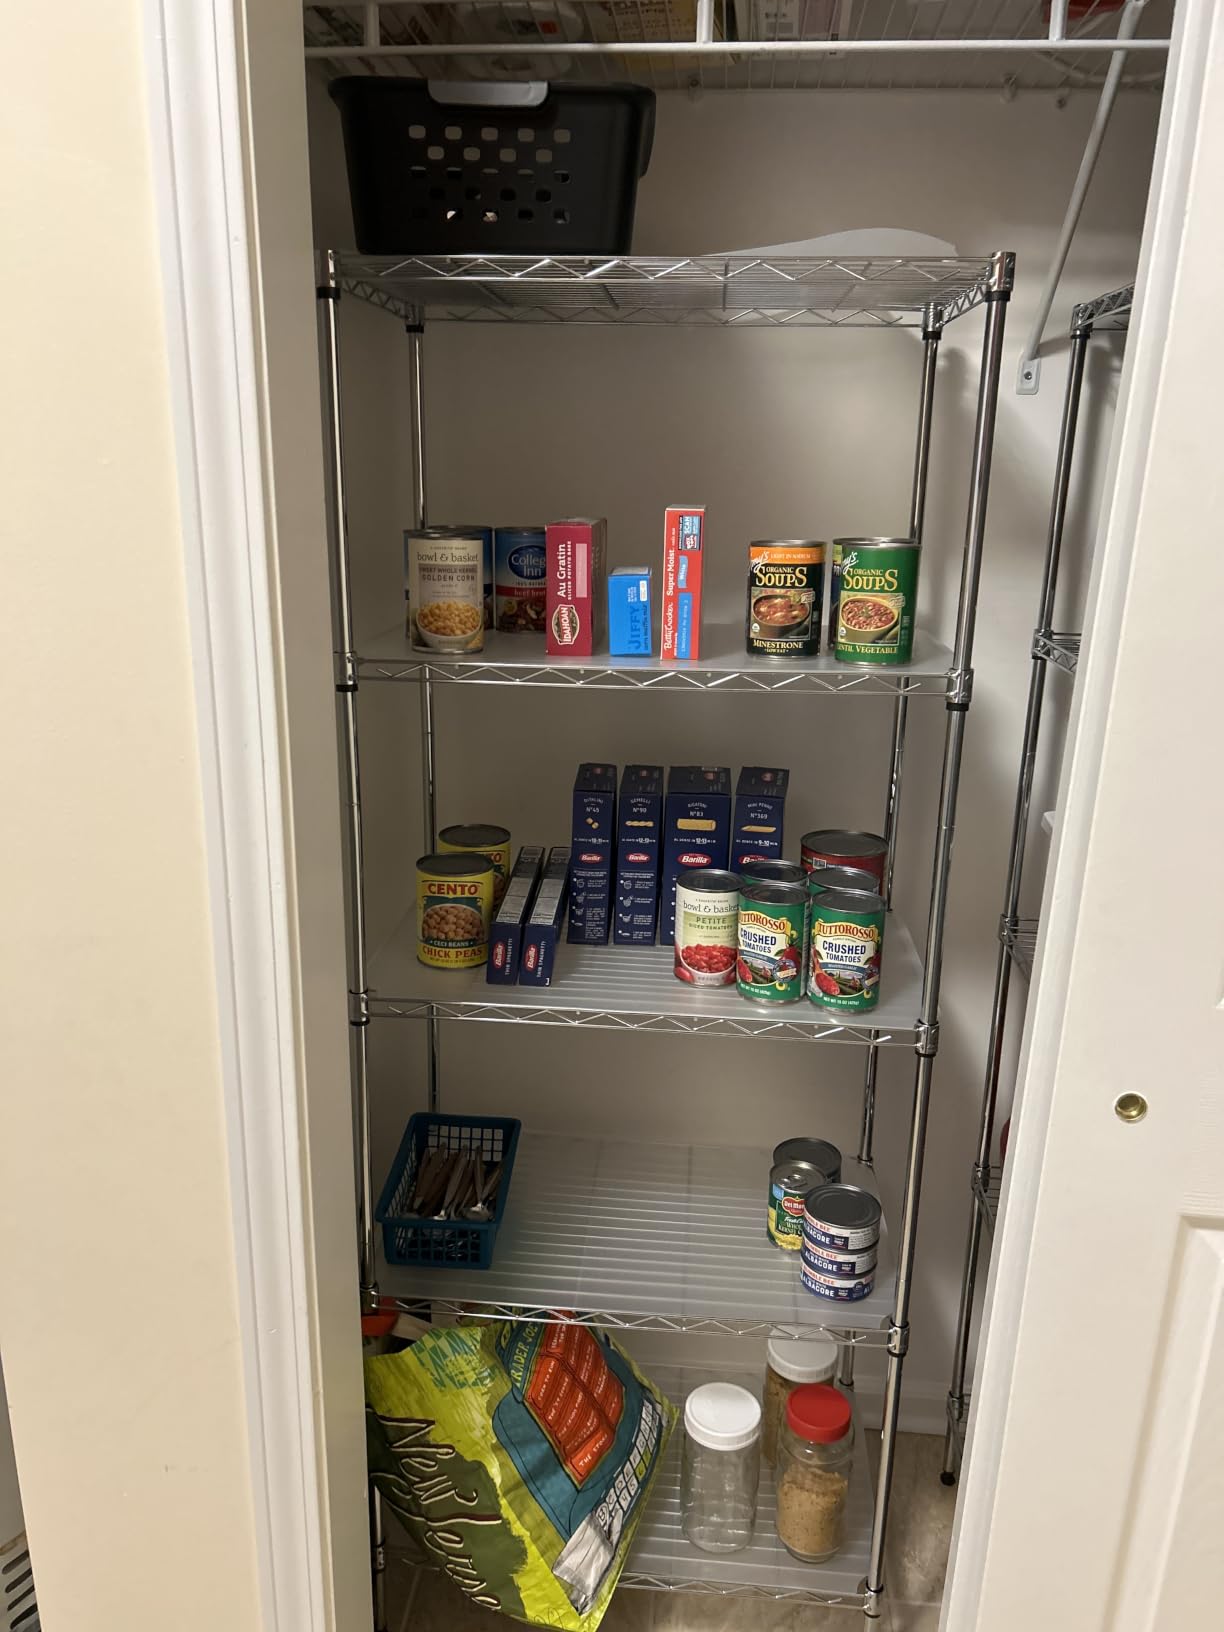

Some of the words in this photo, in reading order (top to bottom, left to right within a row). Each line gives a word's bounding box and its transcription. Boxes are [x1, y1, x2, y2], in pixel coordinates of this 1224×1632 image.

[417, 551, 437, 562] bowl
[439, 552, 448, 562] &
[450, 552, 479, 563] basket
[511, 553, 547, 569] Colleg
[556, 543, 567, 580] Gratin
[667, 549, 675, 572] Moist
[422, 574, 454, 582] GOLDEN
[523, 565, 542, 577] Inn
[755, 566, 808, 588] SOUPS
[853, 568, 884, 576] ORGANIC
[666, 573, 676, 596] Super
[843, 568, 898, 591] SOUPS
[557, 581, 567, 598] Au
[664, 602, 673, 631] Crocker
[560, 607, 572, 642] IDAHOAN
[628, 605, 641, 650] JIFFY
[663, 629, 673, 651] Betty
[753, 639, 804, 649] MINESTRONE
[855, 644, 897, 654] VEGETABLE
[581, 853, 602, 862] Barilla
[628, 853, 649, 862] Barilla
[682, 855, 709, 864] Barilla
[428, 883, 478, 896] CENTO
[683, 900, 701, 912] bowl
[703, 905, 712, 913] &
[696, 916, 728, 925] PETITE
[740, 927, 777, 946] CRUSHED
[817, 921, 874, 939] TUTTOROSSO
[422, 945, 450, 959] CHICK
[455, 947, 482, 959] PEAS
[742, 939, 772, 954] TOMATOES
[822, 940, 867, 955] CRUSHED
[527, 947, 536, 969] Barilla
[825, 952, 862, 963] TOMATOES
[804, 1250, 838, 1272] ALBACORE
[803, 1275, 835, 1297] ALBACORE
[578, 1452, 593, 1467] THE
